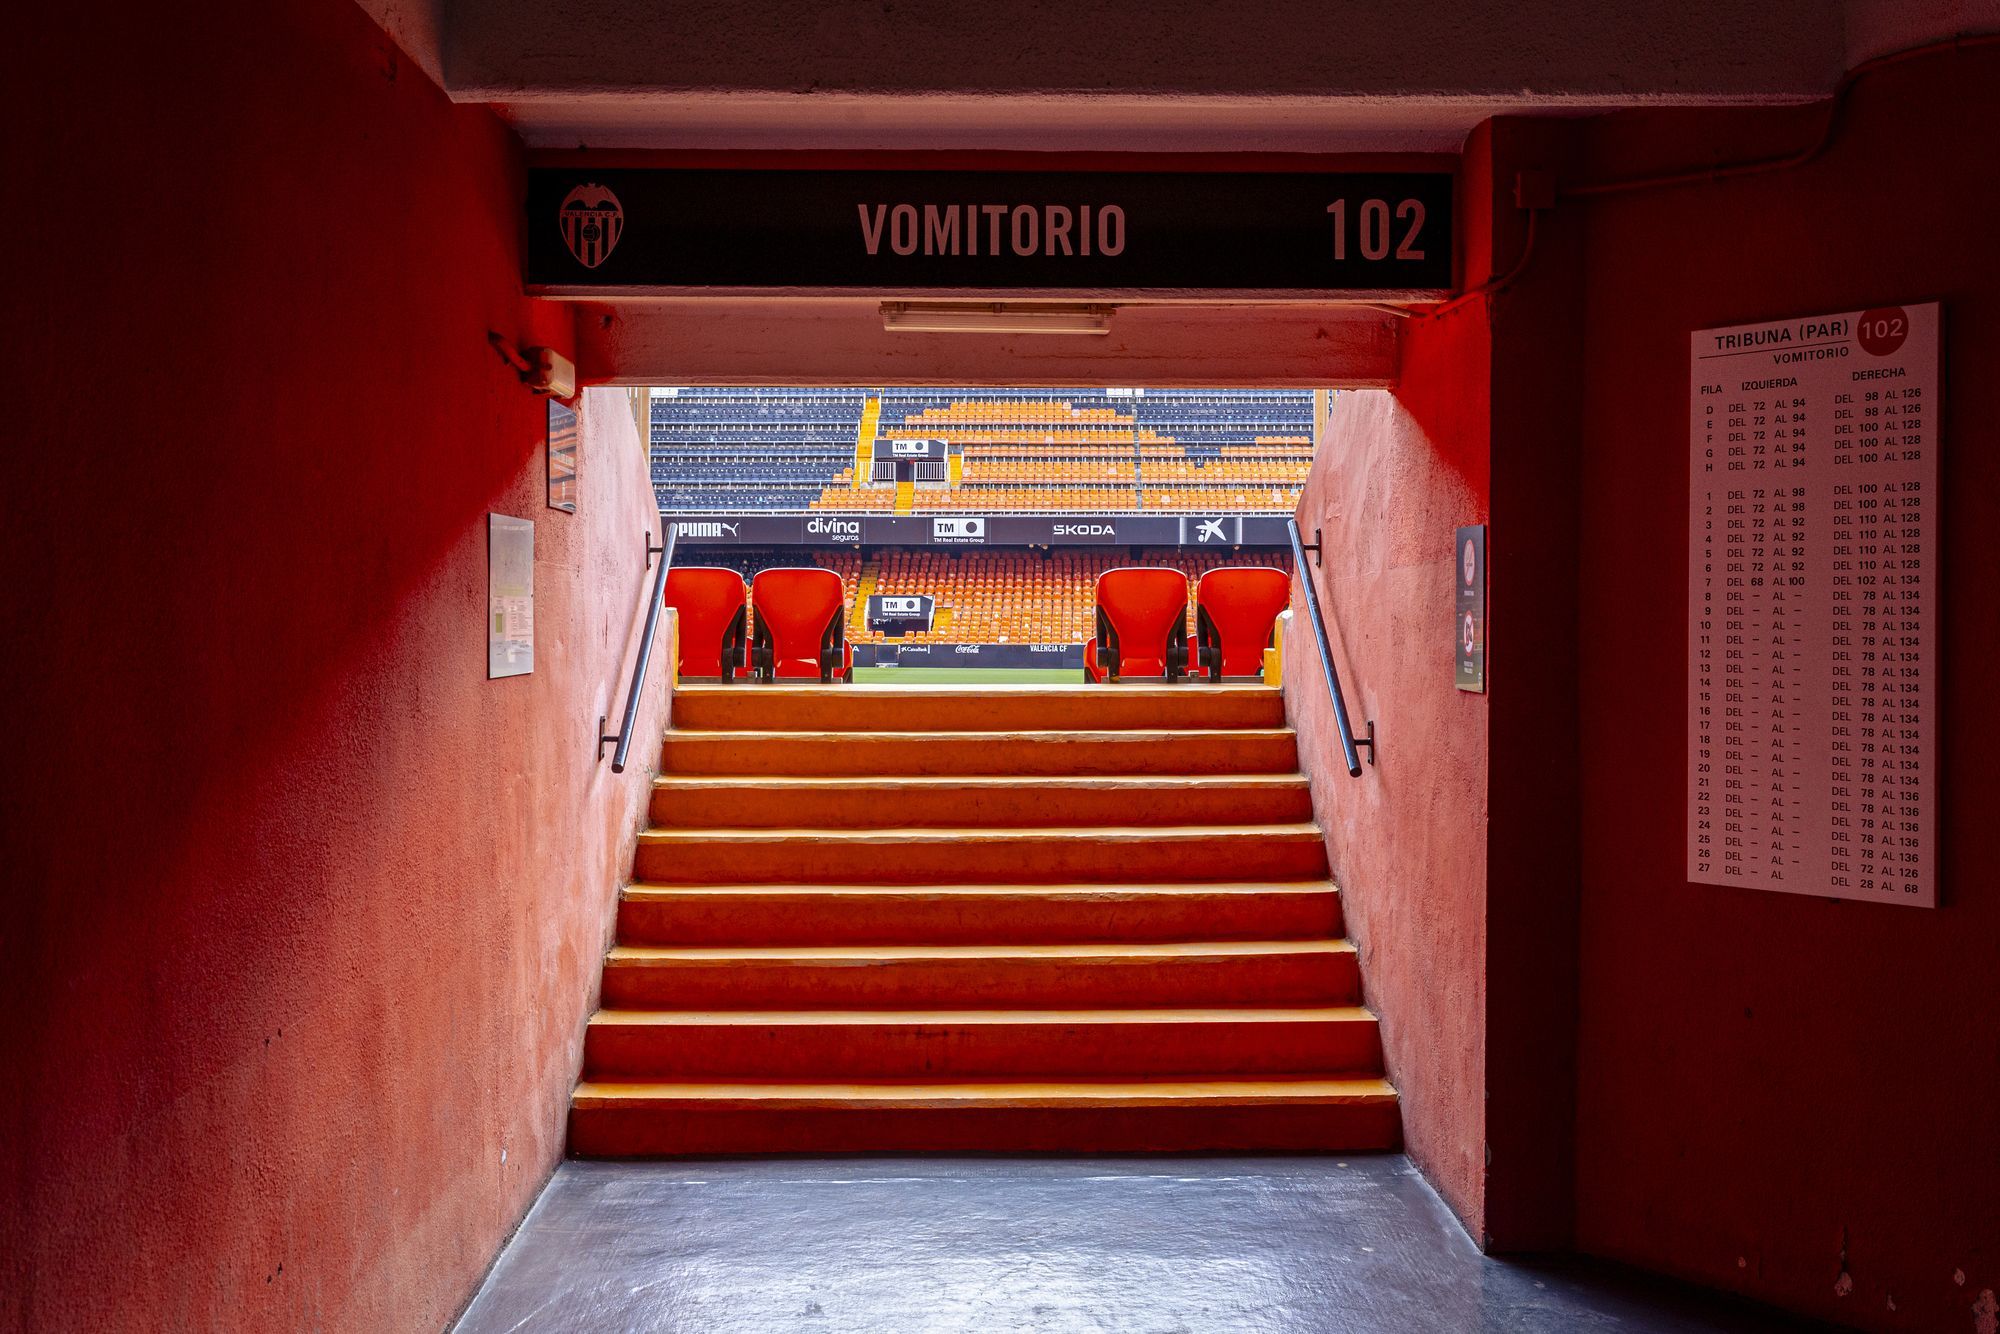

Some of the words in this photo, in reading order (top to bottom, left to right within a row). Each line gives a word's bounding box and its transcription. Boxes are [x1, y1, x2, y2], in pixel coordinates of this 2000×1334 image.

[857, 203, 1126, 257] VOMITORIO
[1326, 198, 1426, 261] 102
[1715, 328, 1792, 350] TRIBUNA
[1800, 320, 1849, 340] (PAR)
[1862, 318, 1904, 340] 102
[1773, 346, 1849, 364] VOMITORIO
[1701, 384, 1722, 395] FILA
[1742, 377, 1798, 391] IZQUIERDA
[1852, 368, 1906, 381] DERECHA
[1706, 406, 1713, 414] D
[1729, 403, 1746, 412] DEL
[1754, 401, 1765, 410] 72
[1775, 400, 1787, 408] AL
[1793, 398, 1806, 408] 94
[1835, 394, 1854, 404] DEL
[1865, 392, 1878, 401] 98
[1885, 390, 1898, 400] AL
[1902, 388, 1921, 398] 126
[1706, 420, 1712, 428] E
[1729, 418, 1746, 427] DEL
[1754, 416, 1765, 425] 72
[1775, 415, 1787, 424] AL
[1793, 413, 1807, 422] 94
[1835, 410, 1854, 419] DEL
[1865, 407, 1878, 416] 98
[1884, 406, 1898, 415] AL
[1902, 404, 1921, 414] 126
[1707, 434, 1712, 443] F
[1728, 433, 1746, 442] DEL
[1753, 431, 1765, 440] 72
[1774, 430, 1787, 438] AL
[1793, 428, 1806, 437] 94
[1835, 424, 1853, 434] DEL
[1859, 423, 1878, 432] 100
[1884, 421, 1898, 430] AL
[1902, 420, 1921, 429] 128
[1706, 449, 1713, 458] G
[1728, 447, 1746, 456] DEL
[1753, 445, 1765, 454] 72
[1774, 444, 1787, 453] AL
[1792, 443, 1806, 452] 94
[1835, 440, 1853, 449] DEL
[1859, 438, 1878, 448] 100
[1884, 437, 1897, 446] AL
[1902, 435, 1920, 444] 128
[1706, 464, 1712, 472] H
[1728, 462, 1745, 470] DEL
[1753, 460, 1765, 469] 72
[1774, 459, 1787, 468] AL
[1792, 458, 1806, 467] 94
[1834, 455, 1854, 464] DEL
[1859, 453, 1878, 463] 100
[1884, 452, 1898, 461] AL
[1902, 450, 1920, 460] 128
[1705, 492, 1710, 500] 1
[1728, 490, 1746, 500] DEL
[1753, 489, 1764, 498] 72
[1774, 488, 1786, 497] AL
[1792, 488, 1805, 496] 98
[1834, 485, 1852, 494] DEL
[1858, 484, 1877, 493] 100
[1884, 484, 1897, 492] AL
[1902, 482, 1920, 491] 128
[679, 522, 721, 536] PUMA
[807, 518, 859, 533] divina
[938, 524, 954, 532] TM
[1706, 521, 1712, 529] 3
[1728, 520, 1745, 528] DEL
[1752, 519, 1764, 528] 72
[1774, 518, 1786, 526] AL
[1792, 517, 1805, 526] 92
[1834, 516, 1852, 525] DEL
[1859, 514, 1877, 524] 110
[1884, 514, 1896, 523] AL
[1901, 513, 1920, 522] 128
[1706, 550, 1712, 558] 5
[1728, 549, 1744, 557] DEL
[1752, 548, 1764, 556] 72
[1773, 548, 1786, 556] AL
[1792, 547, 1804, 556] 92
[1834, 546, 1852, 555] DEL
[1859, 545, 1876, 554] 110
[1883, 545, 1896, 554] AL
[1901, 544, 1920, 553] 128
[1706, 578, 1711, 586] 7
[1727, 578, 1744, 586] DEL
[1751, 577, 1764, 586] 68
[1772, 577, 1785, 586] AL
[1789, 577, 1805, 586] 100
[1833, 576, 1852, 585] DEL
[1857, 576, 1876, 585] 102
[1883, 576, 1896, 584] AL
[1900, 575, 1920, 584] 134
[1700, 621, 1711, 630] 10
[1726, 621, 1744, 630] DEL
[1772, 622, 1785, 630] AL
[1833, 622, 1852, 630] DEL
[1862, 622, 1876, 630] 78
[1883, 622, 1896, 630] AL
[1900, 622, 1920, 631] 134
[1700, 707, 1710, 715] 16
[1726, 708, 1743, 716] DEL
[1772, 709, 1784, 718] AL
[1832, 712, 1851, 721] DEL
[1862, 713, 1874, 722] 78
[1882, 714, 1895, 723] AL
[1900, 714, 1920, 724] 134
[1698, 792, 1711, 800] 22
[1726, 794, 1743, 803] DEL
[1772, 798, 1784, 806] AL
[1832, 802, 1851, 811] DEL
[1861, 804, 1874, 813] 78
[1882, 805, 1895, 815] AL
[1900, 807, 1919, 816] 136
[1698, 863, 1710, 872] 27
[1725, 866, 1742, 875] DEL
[1771, 870, 1784, 880] AL
[1832, 876, 1850, 886] DEL
[1860, 879, 1874, 889] 28
[1881, 882, 1894, 891] AL
[1904, 884, 1918, 894] 68
